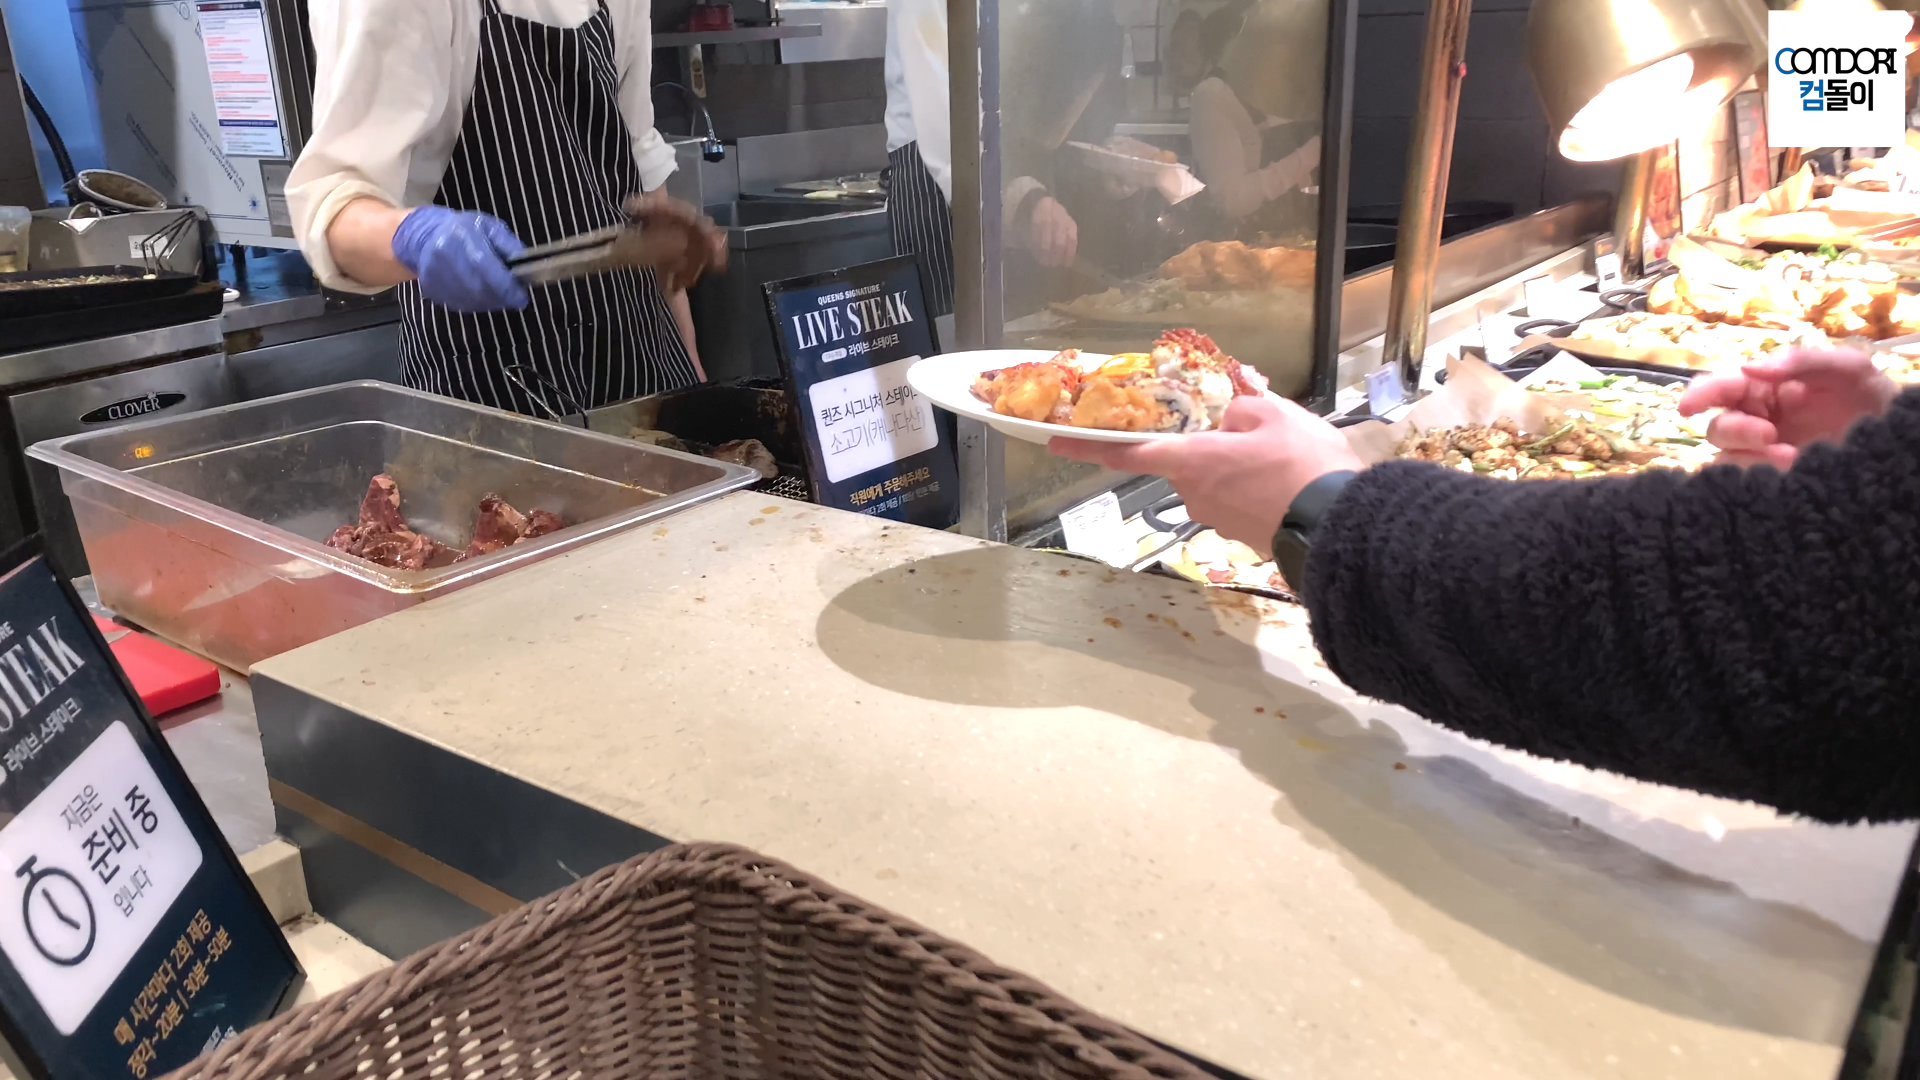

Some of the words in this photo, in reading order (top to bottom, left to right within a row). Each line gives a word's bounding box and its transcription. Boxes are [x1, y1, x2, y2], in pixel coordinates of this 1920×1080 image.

[817, 293, 845, 306] QUEENS
[845, 283, 881, 299] SIGNATURE
[792, 306, 845, 350] LIVE
[846, 290, 914, 336] STEAK
[848, 341, 870, 357] 라이브
[871, 333, 900, 351] 스테이크
[108, 397, 161, 420] CLOVER
[820, 406, 844, 427] 퀸즈
[844, 393, 884, 419] 시그니처
[885, 385, 918, 406] 스테이
[830, 405, 926, 455] 소고기(캐나다산)
[849, 483, 884, 506] 직원에게
[883, 466, 931, 494] 주문해주세요
[3, 732, 43, 772] 라이브
[40, 697, 82, 744] 스테이크
[60, 784, 103, 831] 지금은
[81, 808, 139, 885] 준비
[124, 785, 158, 834] 중
[113, 864, 153, 918] 입니다
[113, 1016, 136, 1046] 매
[130, 959, 177, 1026] 시간마다
[170, 934, 194, 970] 2회
[186, 908, 212, 945] 제공
